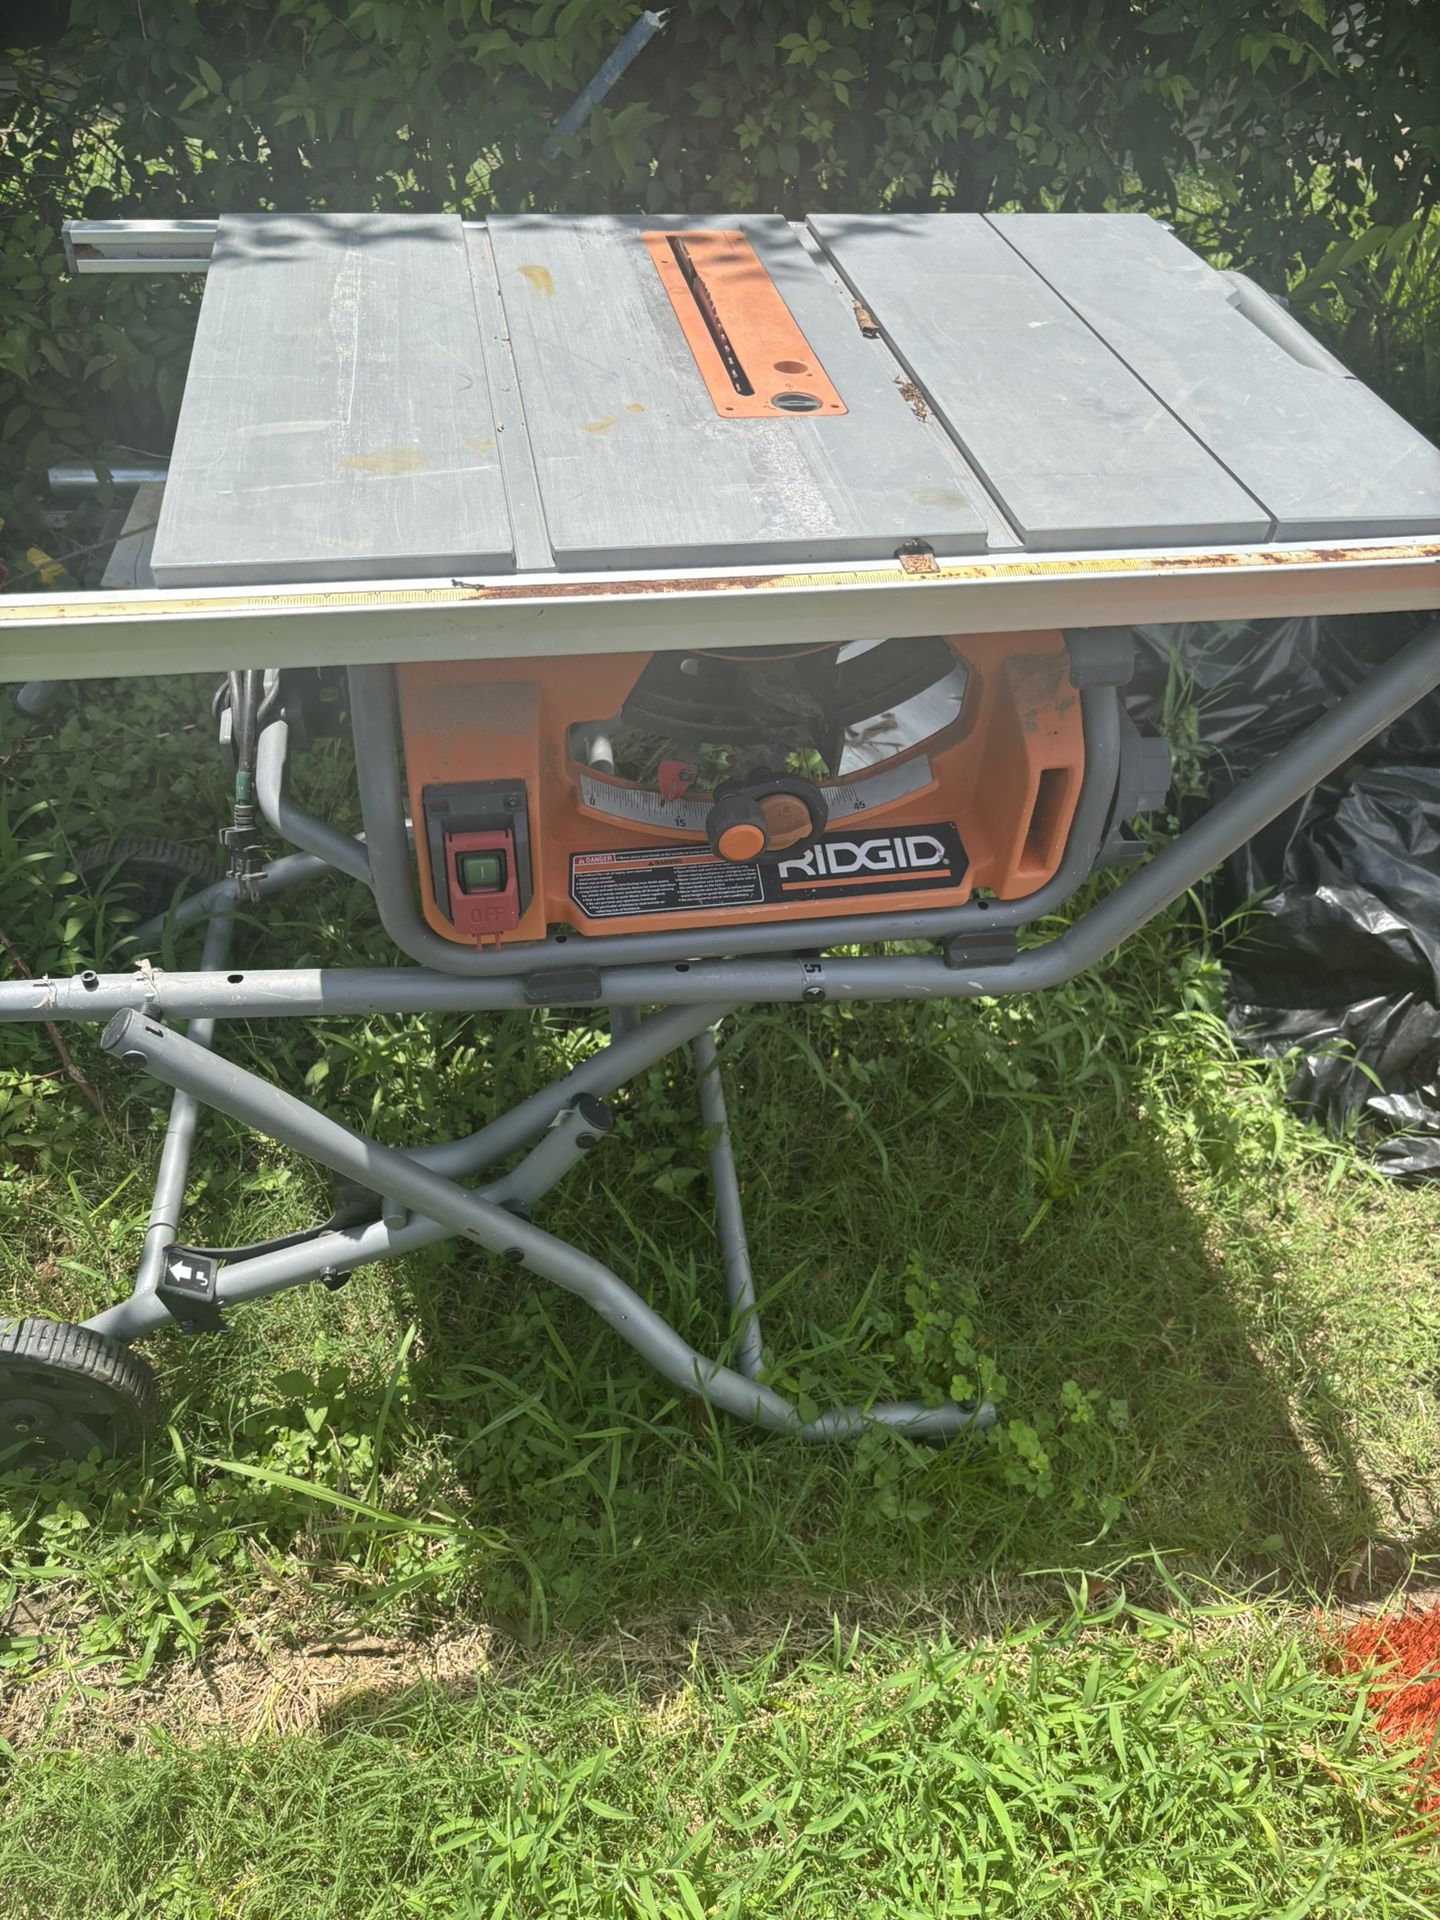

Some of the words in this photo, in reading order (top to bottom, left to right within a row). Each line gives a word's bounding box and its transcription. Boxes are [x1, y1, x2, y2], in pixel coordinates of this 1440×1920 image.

[589, 797, 596, 806] 0
[853, 802, 866, 810] 45
[675, 818, 687, 828] 15
[586, 855, 613, 863] DANGER
[778, 835, 945, 878] RIDGID
[470, 906, 505, 922] OFF
[804, 963, 822, 973] 5
